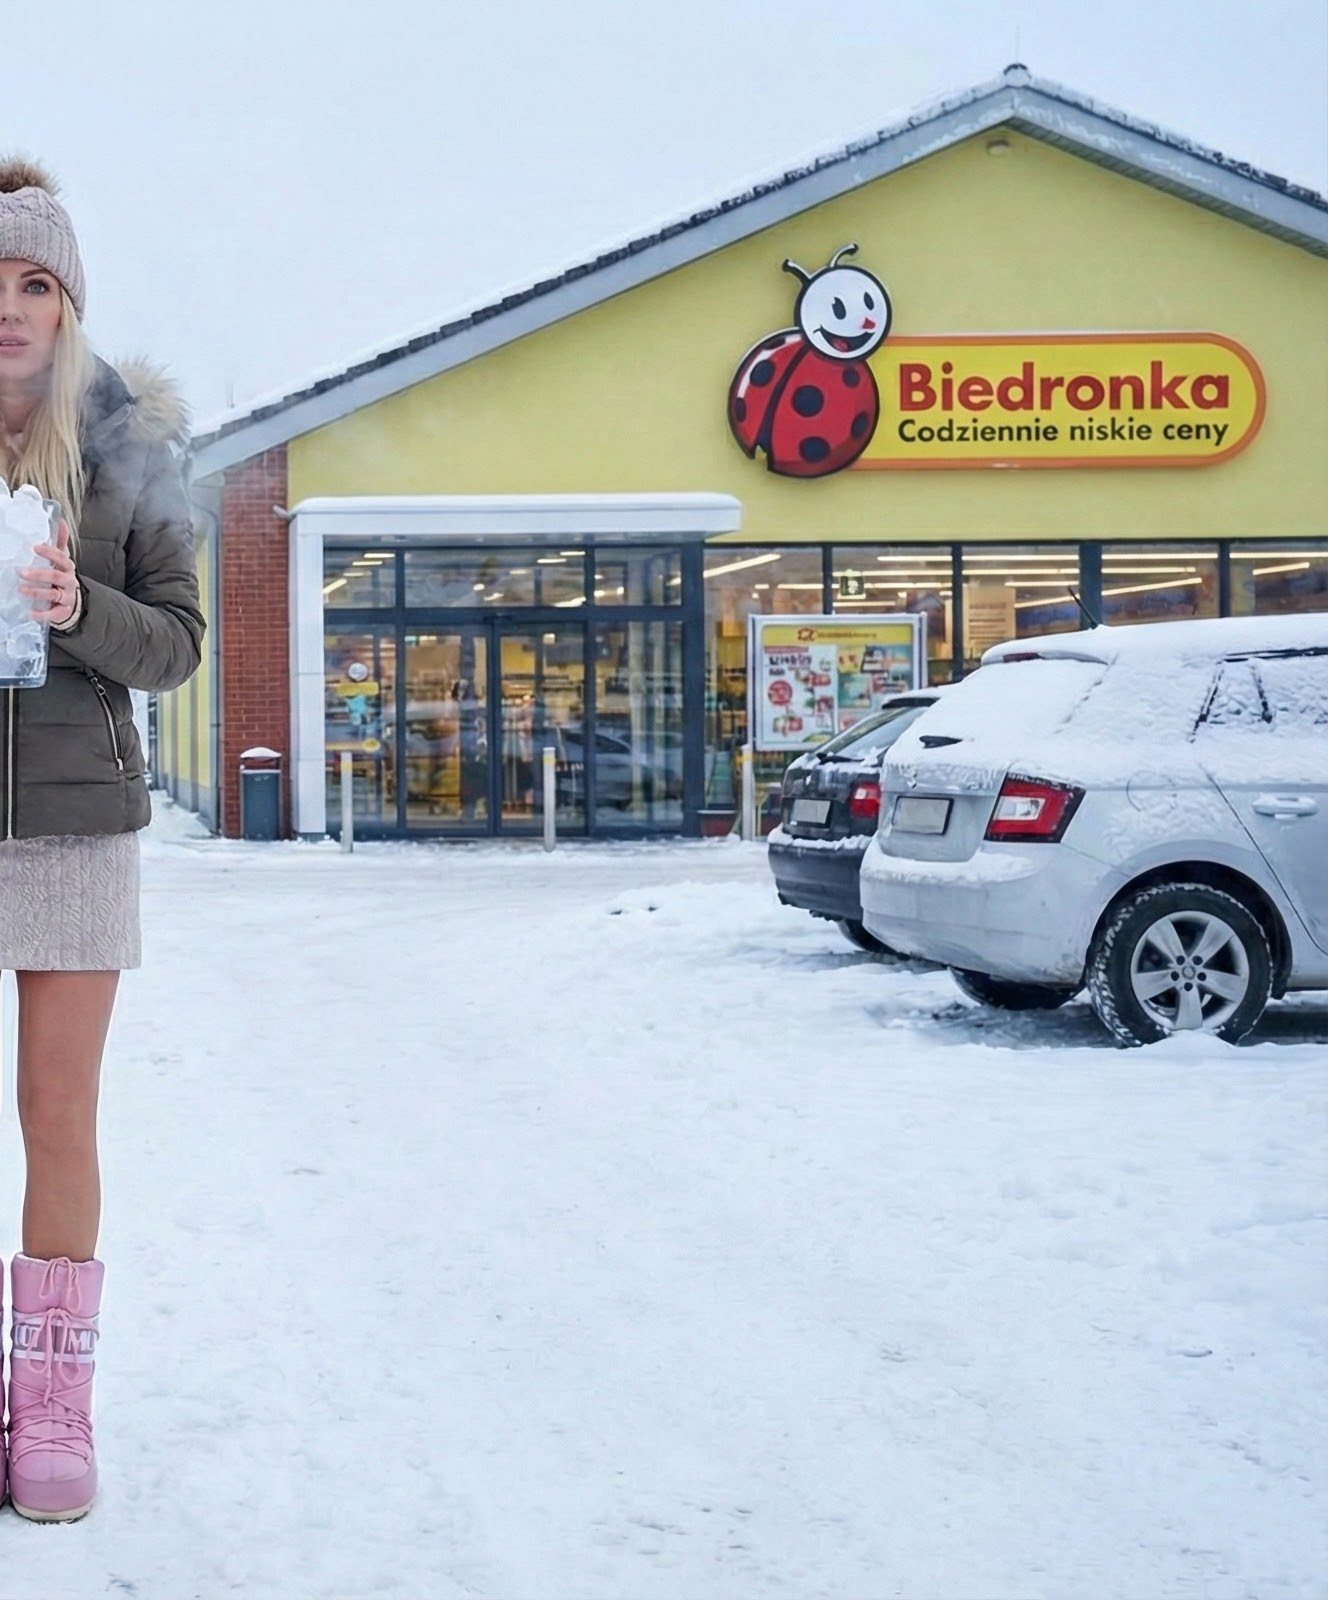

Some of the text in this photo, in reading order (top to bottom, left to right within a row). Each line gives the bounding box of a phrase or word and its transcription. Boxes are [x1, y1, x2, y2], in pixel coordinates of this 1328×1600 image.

[899, 360, 1230, 412] Biedronka
[898, 416, 1229, 446] Codziennie niskie ceny
